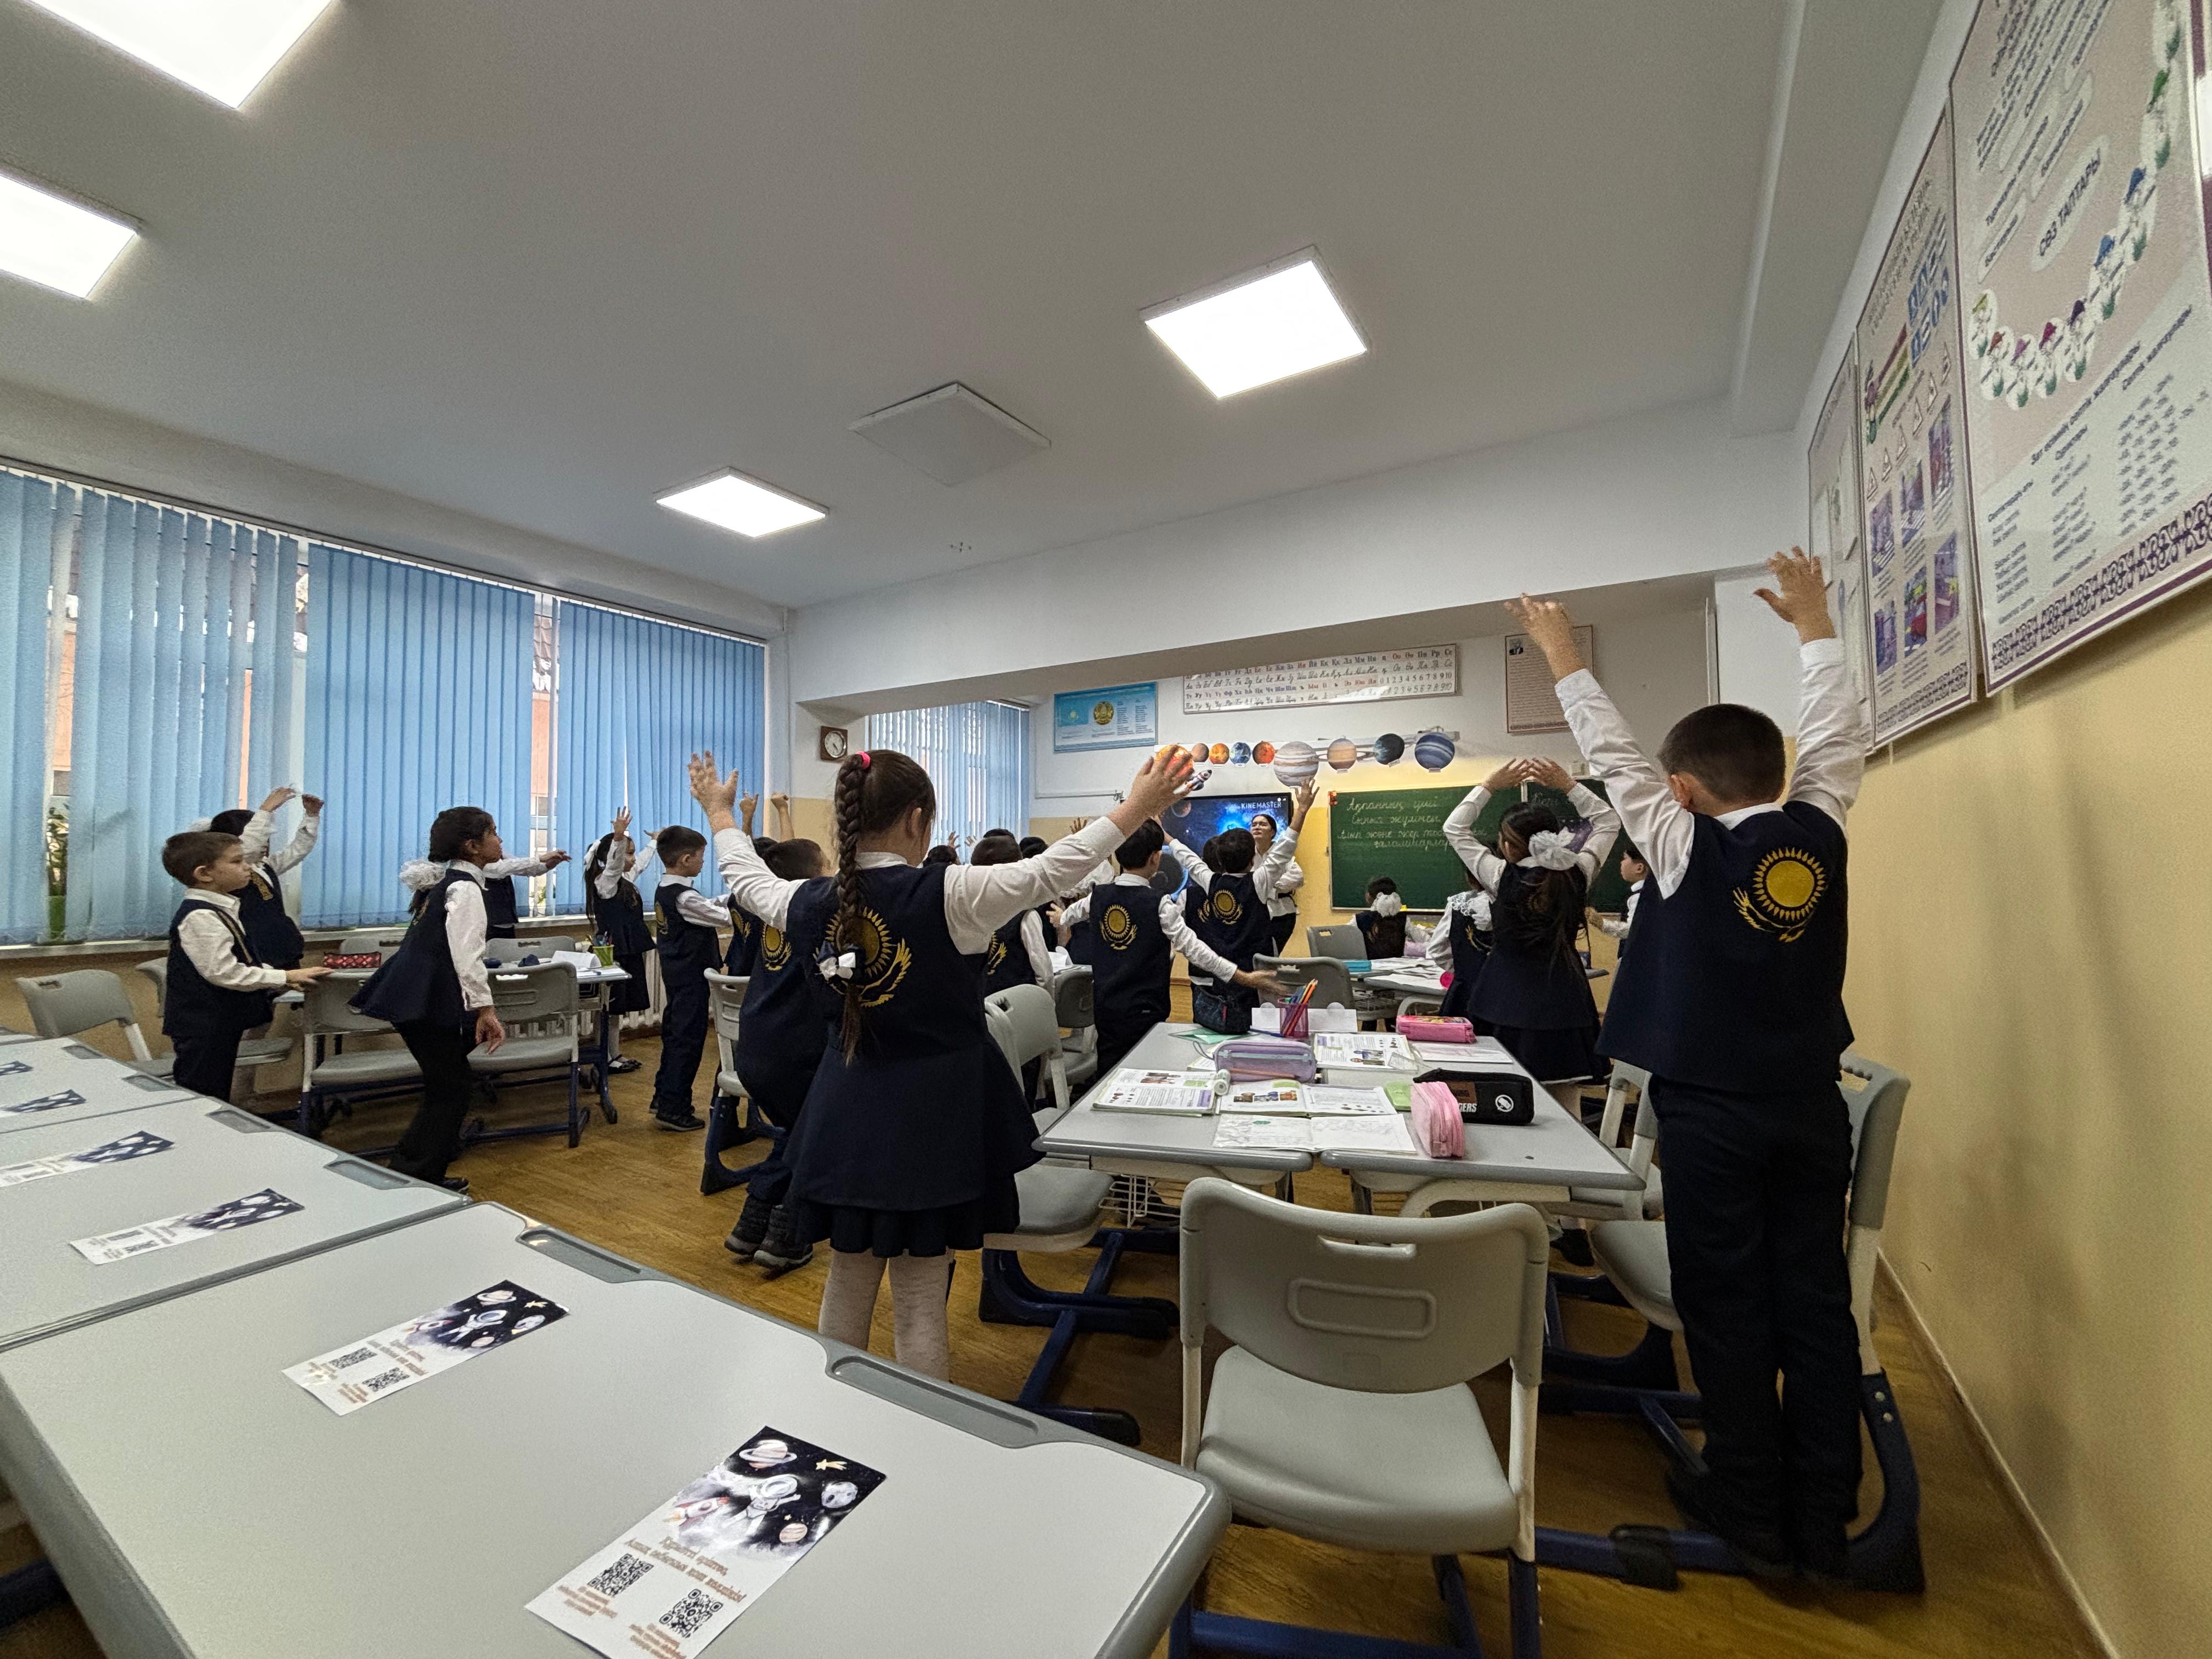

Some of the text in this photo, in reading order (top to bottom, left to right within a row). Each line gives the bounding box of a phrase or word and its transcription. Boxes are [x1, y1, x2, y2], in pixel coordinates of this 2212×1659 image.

[1431, 650, 1440, 658] Рр
[1241, 801, 1282, 809] KINEMASTER
[1459, 1103, 1477, 1113] GERS
